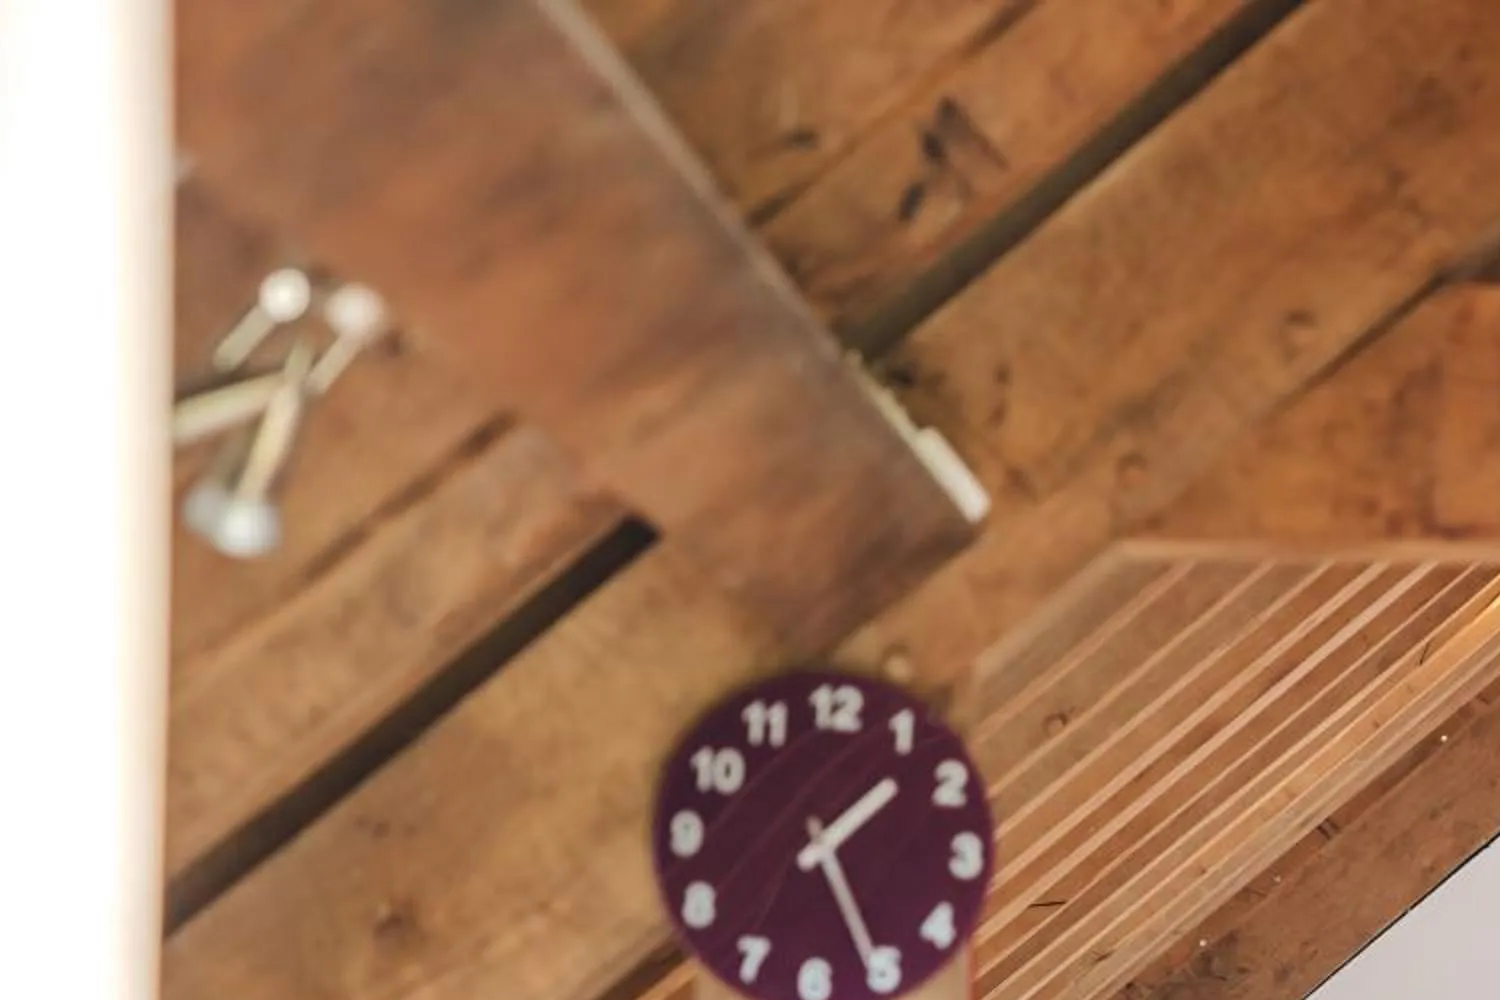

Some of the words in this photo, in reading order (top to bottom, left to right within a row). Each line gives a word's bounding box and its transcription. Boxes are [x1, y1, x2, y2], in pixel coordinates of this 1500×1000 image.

[742, 700, 789, 747] 11
[810, 685, 863, 732] 12
[890, 709, 914, 754] 1
[691, 747, 745, 794] 10
[932, 760, 968, 807] 2
[949, 832, 983, 880] 3
[682, 882, 716, 928] 8
[920, 902, 956, 949] 4
[737, 936, 771, 983] 7
[866, 946, 902, 994] 5
